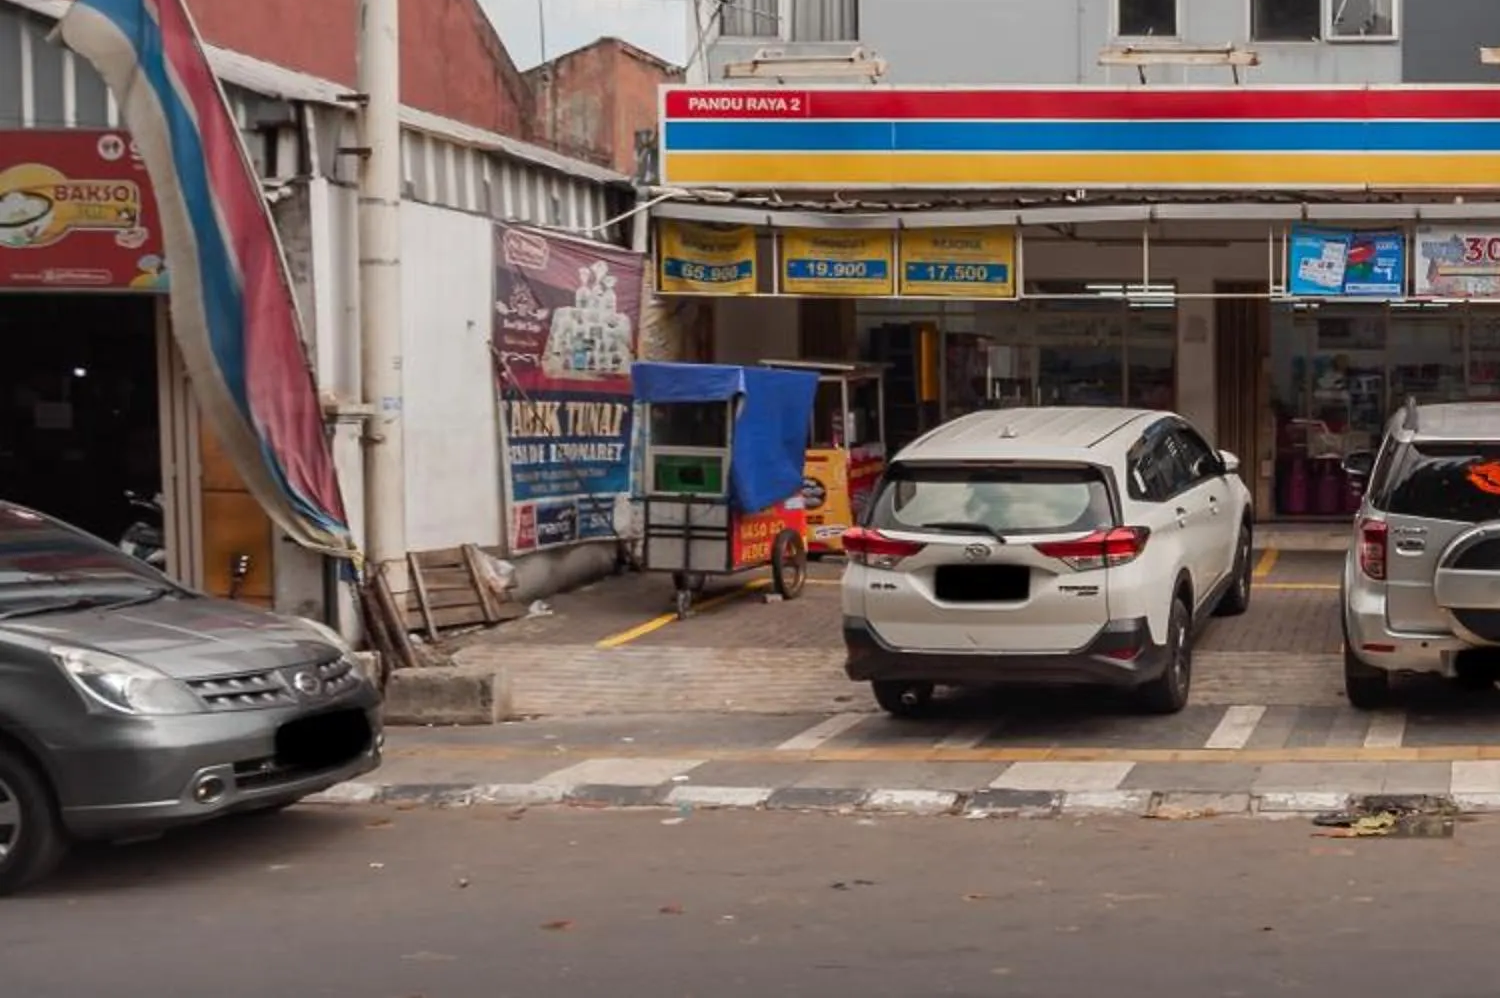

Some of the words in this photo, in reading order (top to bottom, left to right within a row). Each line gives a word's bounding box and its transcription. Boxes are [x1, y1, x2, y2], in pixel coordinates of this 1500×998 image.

[689, 97, 742, 110] PANDU
[746, 97, 787, 110] RAYA
[790, 97, 801, 110] 2
[55, 186, 130, 201] BAKSO
[806, 262, 867, 278] 19.900
[927, 265, 988, 281] 17.500
